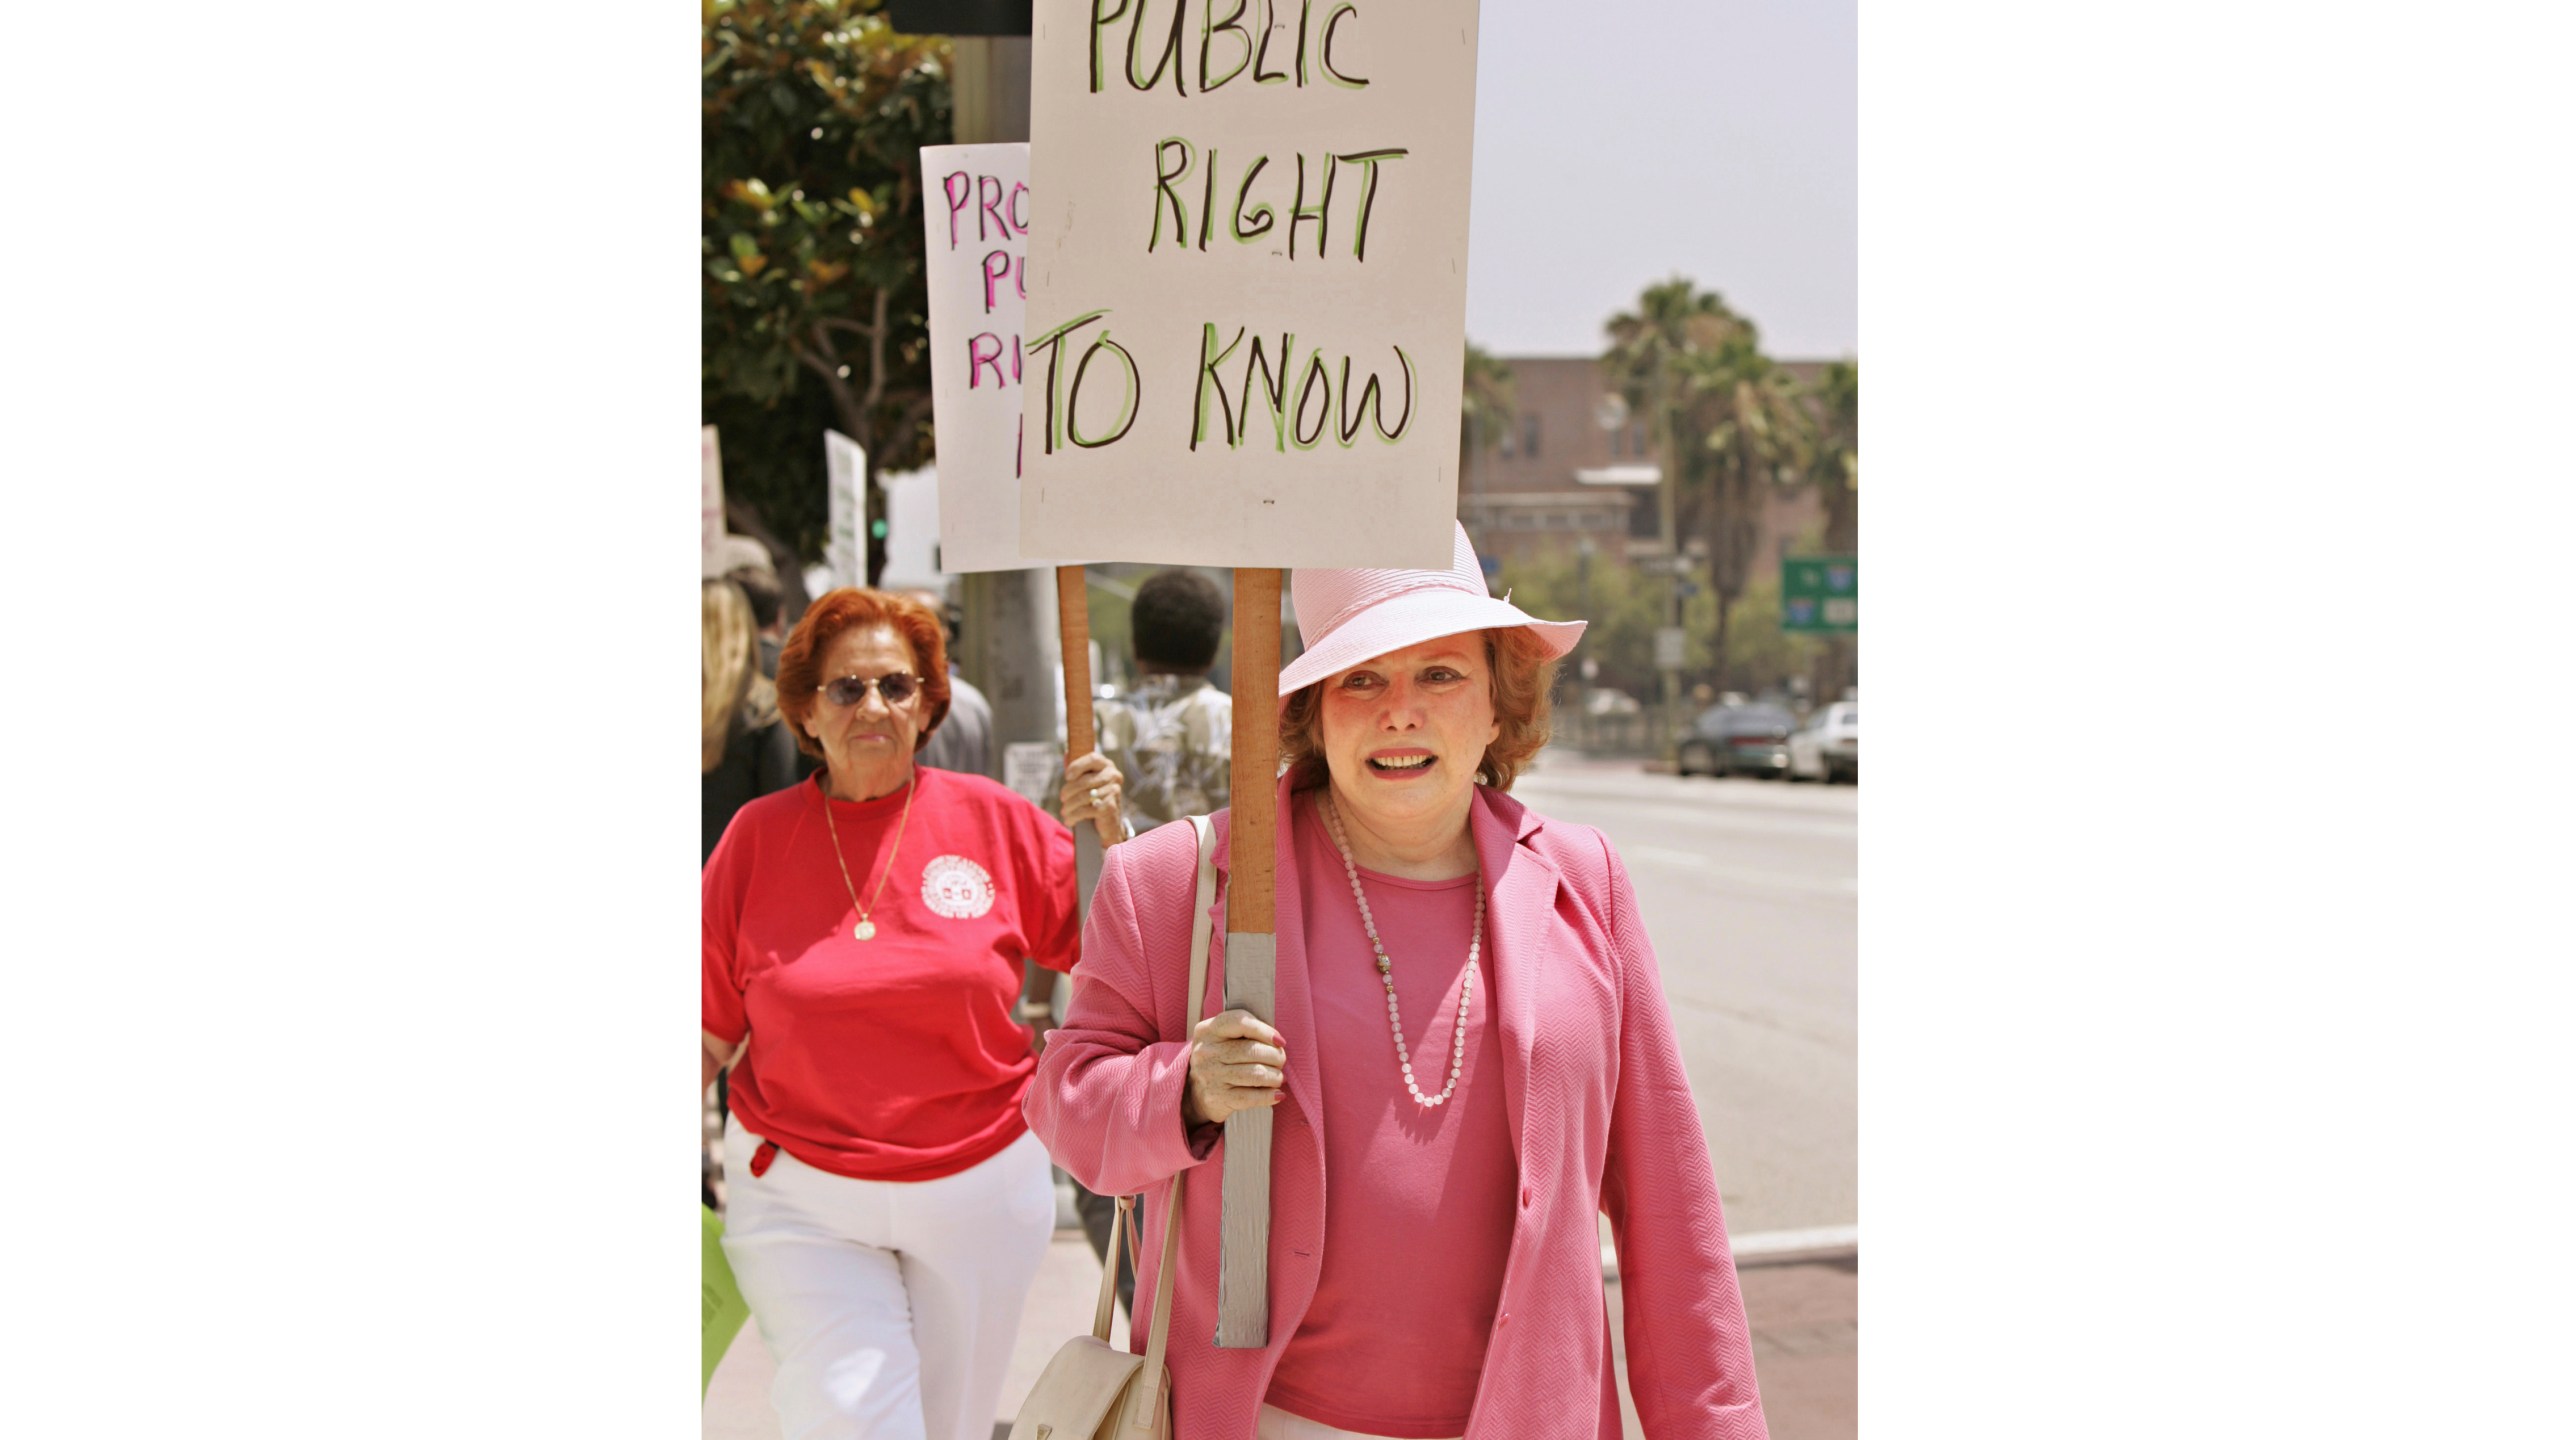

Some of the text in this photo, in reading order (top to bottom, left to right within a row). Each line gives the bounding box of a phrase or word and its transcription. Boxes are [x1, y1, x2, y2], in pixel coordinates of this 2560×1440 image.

[1090, 0, 1370, 97] PUBLIC
[1148, 136, 1409, 262] RIGHT
[1025, 309, 1140, 454] TO
[1189, 322, 1418, 454] KNOW
